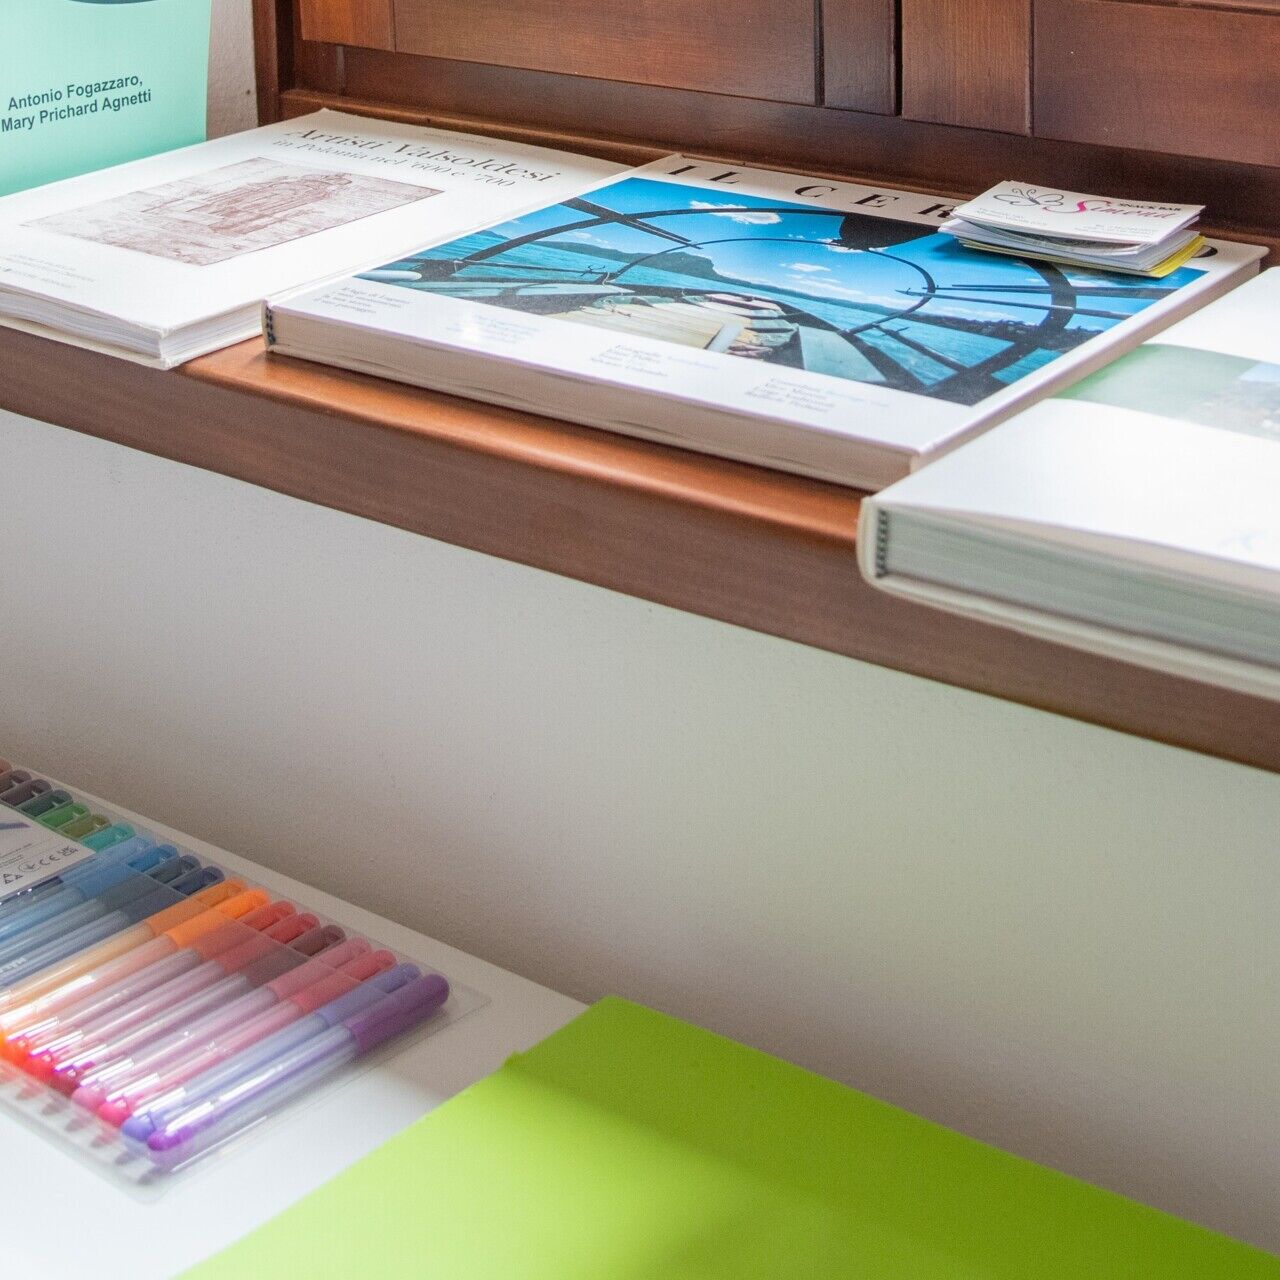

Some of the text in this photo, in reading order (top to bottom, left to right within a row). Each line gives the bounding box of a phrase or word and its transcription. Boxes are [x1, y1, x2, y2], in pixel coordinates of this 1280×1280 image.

[0, 88, 152, 132] Mary Prichard Agnetti
[7, 74, 144, 111] Antonio Fogazzaro,
[284, 129, 393, 150] Artisti
[394, 143, 561, 182] Valsoldesi
[296, 142, 368, 160] Polonia
[666, 164, 741, 185] IL
